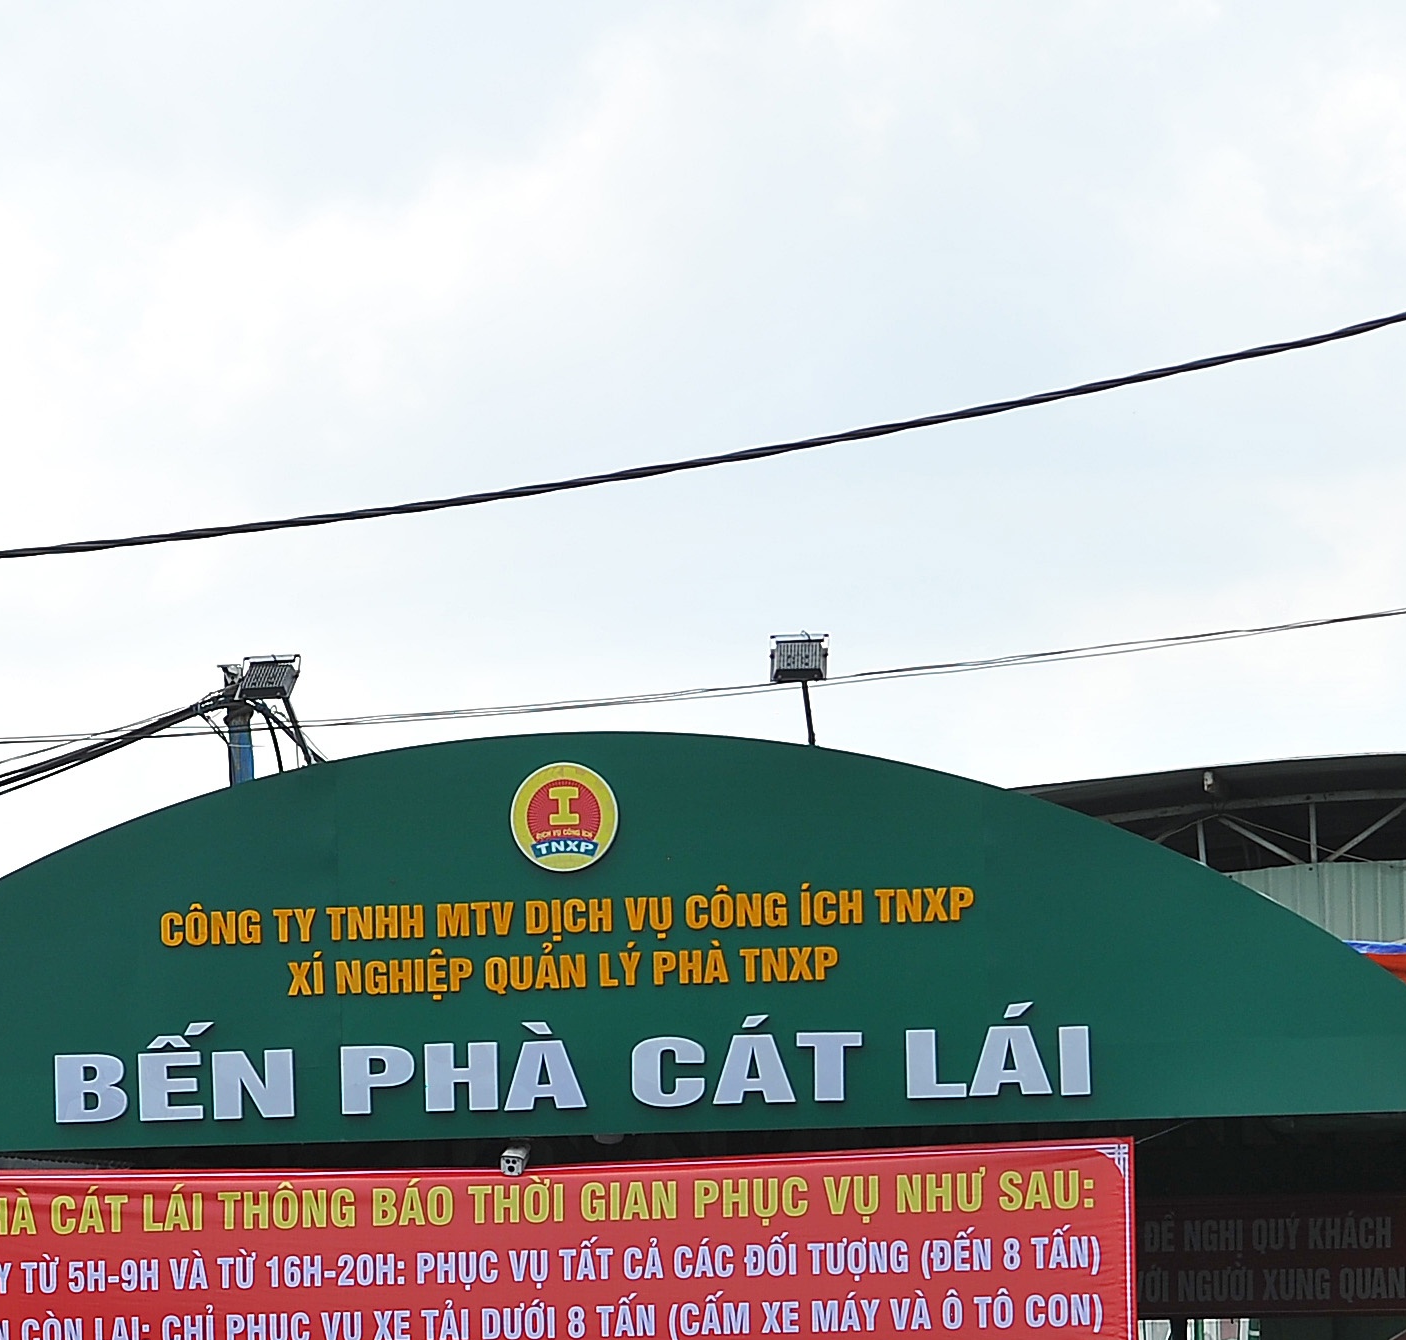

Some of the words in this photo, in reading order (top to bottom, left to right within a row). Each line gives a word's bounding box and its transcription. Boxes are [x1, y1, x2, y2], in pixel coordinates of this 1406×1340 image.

[536, 840, 594, 855] TNXP
[160, 904, 262, 946] CÔNG
[273, 906, 317, 943] TY
[326, 904, 425, 941] TNHH
[436, 900, 514, 938] MTV
[525, 898, 613, 942] DỊCH
[625, 896, 673, 940] VỤ
[685, 884, 788, 930] CÔNG
[800, 882, 863, 926] ÍCH
[875, 886, 975, 924] TNXP
[288, 950, 325, 996] XÍ
[336, 949, 473, 1000] NGHIỆP
[484, 942, 586, 995] QUẢN
[599, 942, 642, 987] LÝ
[653, 940, 729, 986] PHÀ
[739, 946, 839, 983] TNXP
[54, 1021, 295, 1124] BẾN
[340, 1021, 588, 1115] PHÀ
[631, 1014, 864, 1107] CÁT
[905, 1002, 1093, 1098] LÁI
[50, 1187, 128, 1235] CÁT
[143, 1185, 204, 1232] LÁI
[217, 1182, 356, 1230] THÔNG
[372, 1178, 453, 1228] BÁO
[468, 1176, 565, 1224] THỜI
[580, 1180, 678, 1221] GIAN
[693, 1176, 808, 1227] PHỤC
[823, 1175, 880, 1223] VỤ
[895, 1166, 986, 1214] NHƯ
[998, 1169, 1095, 1211] SAU:
[20, 1253, 60, 1294] TỪ
[68, 1258, 159, 1293] 5H-9H
[169, 1250, 210, 1290] VÀ
[217, 1249, 257, 1290] TỪ
[265, 1252, 405, 1289] 16H-20H:
[416, 1249, 499, 1292] PHỤC
[508, 1248, 550, 1286] VỤ
[560, 1238, 614, 1282] TẤT
[622, 1235, 664, 1280] CẢ
[673, 1236, 734, 1279] CÁC
[744, 1232, 798, 1278] ĐỐI
[808, 1237, 910, 1281] TƯỢNG
[921, 1229, 991, 1280] (ĐẾN
[1002, 1235, 1021, 1271] 8
[1031, 1225, 1100, 1276] TẤN)
[1184, 1219, 1243, 1258] NGHỊ
[1252, 1212, 1300, 1255] QUÝ
[1308, 1211, 1392, 1250] KHÁCH
[1178, 1261, 1254, 1303] NGƯỜI
[1263, 1268, 1331, 1300] XUNG
[484, 1297, 556, 1340] DƯỚI
[566, 1306, 586, 1338] 8
[596, 1294, 656, 1337] TẤN
[761, 1299, 799, 1334] XE
[810, 1293, 879, 1333] MÁY
[890, 1290, 933, 1331] VÀ
[942, 1288, 964, 1329] Ô
[973, 1288, 1015, 1329] TÔ
[1025, 1291, 1102, 1333] CON)
